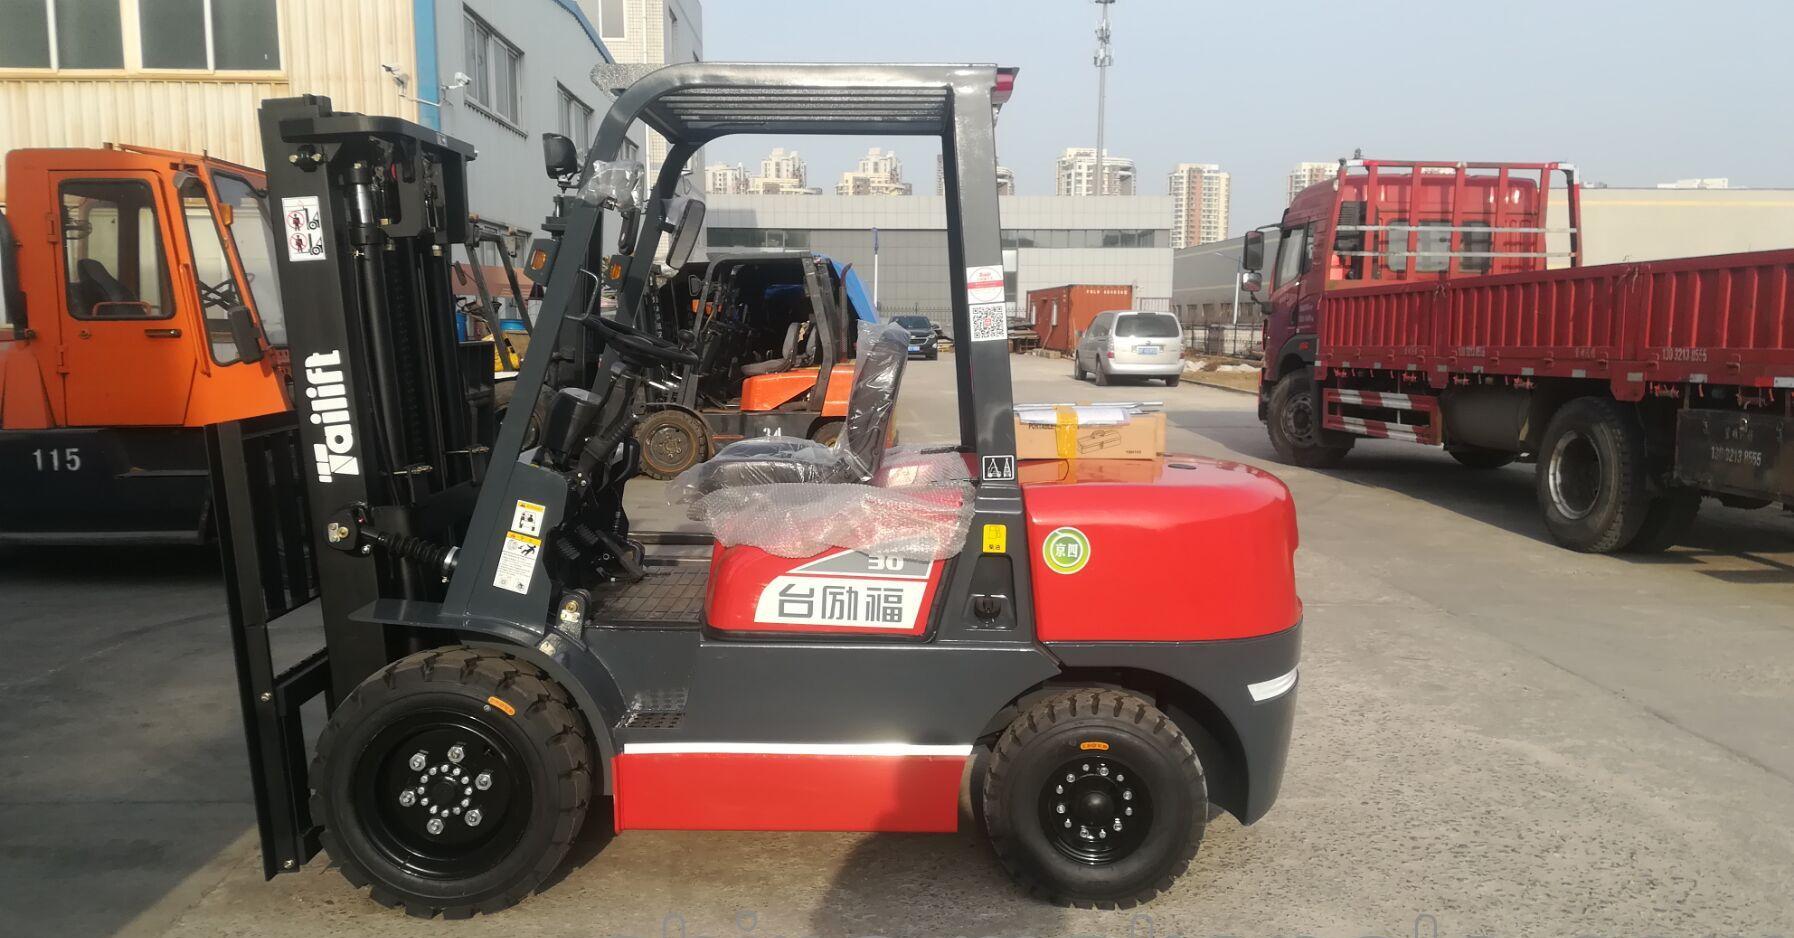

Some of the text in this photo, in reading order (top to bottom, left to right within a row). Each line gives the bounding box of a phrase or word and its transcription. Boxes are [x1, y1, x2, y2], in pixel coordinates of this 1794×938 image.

[305, 350, 359, 483] Tailift
[32, 448, 81, 471] 115
[1055, 543, 1079, 558] 京四
[778, 583, 904, 623] 台励福
